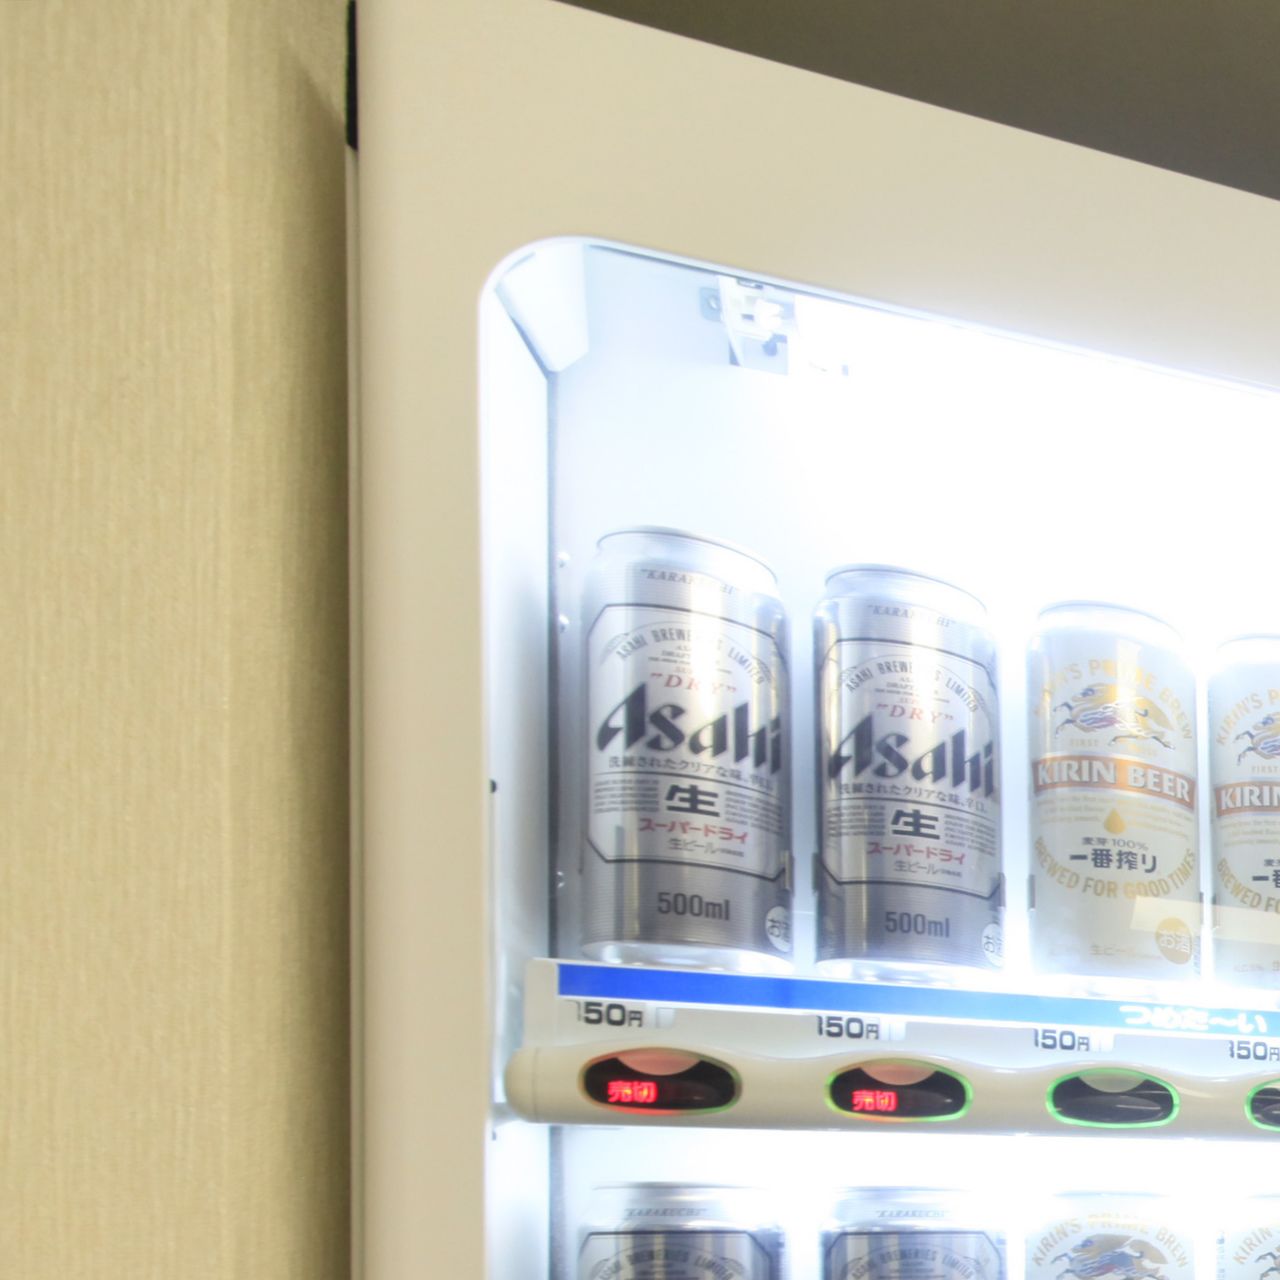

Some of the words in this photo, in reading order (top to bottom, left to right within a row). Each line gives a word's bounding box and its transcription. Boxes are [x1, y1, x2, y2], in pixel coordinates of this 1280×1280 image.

[596, 681, 782, 775] Asahi
[828, 713, 994, 798] Asahi
[1037, 758, 1117, 787] KIRIN
[1127, 764, 1190, 802] BEER
[665, 784, 721, 818] 生
[639, 817, 748, 844] スーパードライ
[891, 809, 940, 840] 生
[867, 842, 966, 865] スーパードライ
[1069, 848, 1158, 874] 一番搾り
[1083, 877, 1118, 897] FOR
[1123, 876, 1171, 899] GOOD
[657, 891, 731, 921] 500ml
[885, 911, 950, 938] 500ml
[576, 1001, 643, 1028] 50円
[607, 1080, 656, 1103] 売切
[852, 1090, 896, 1112] 売切
